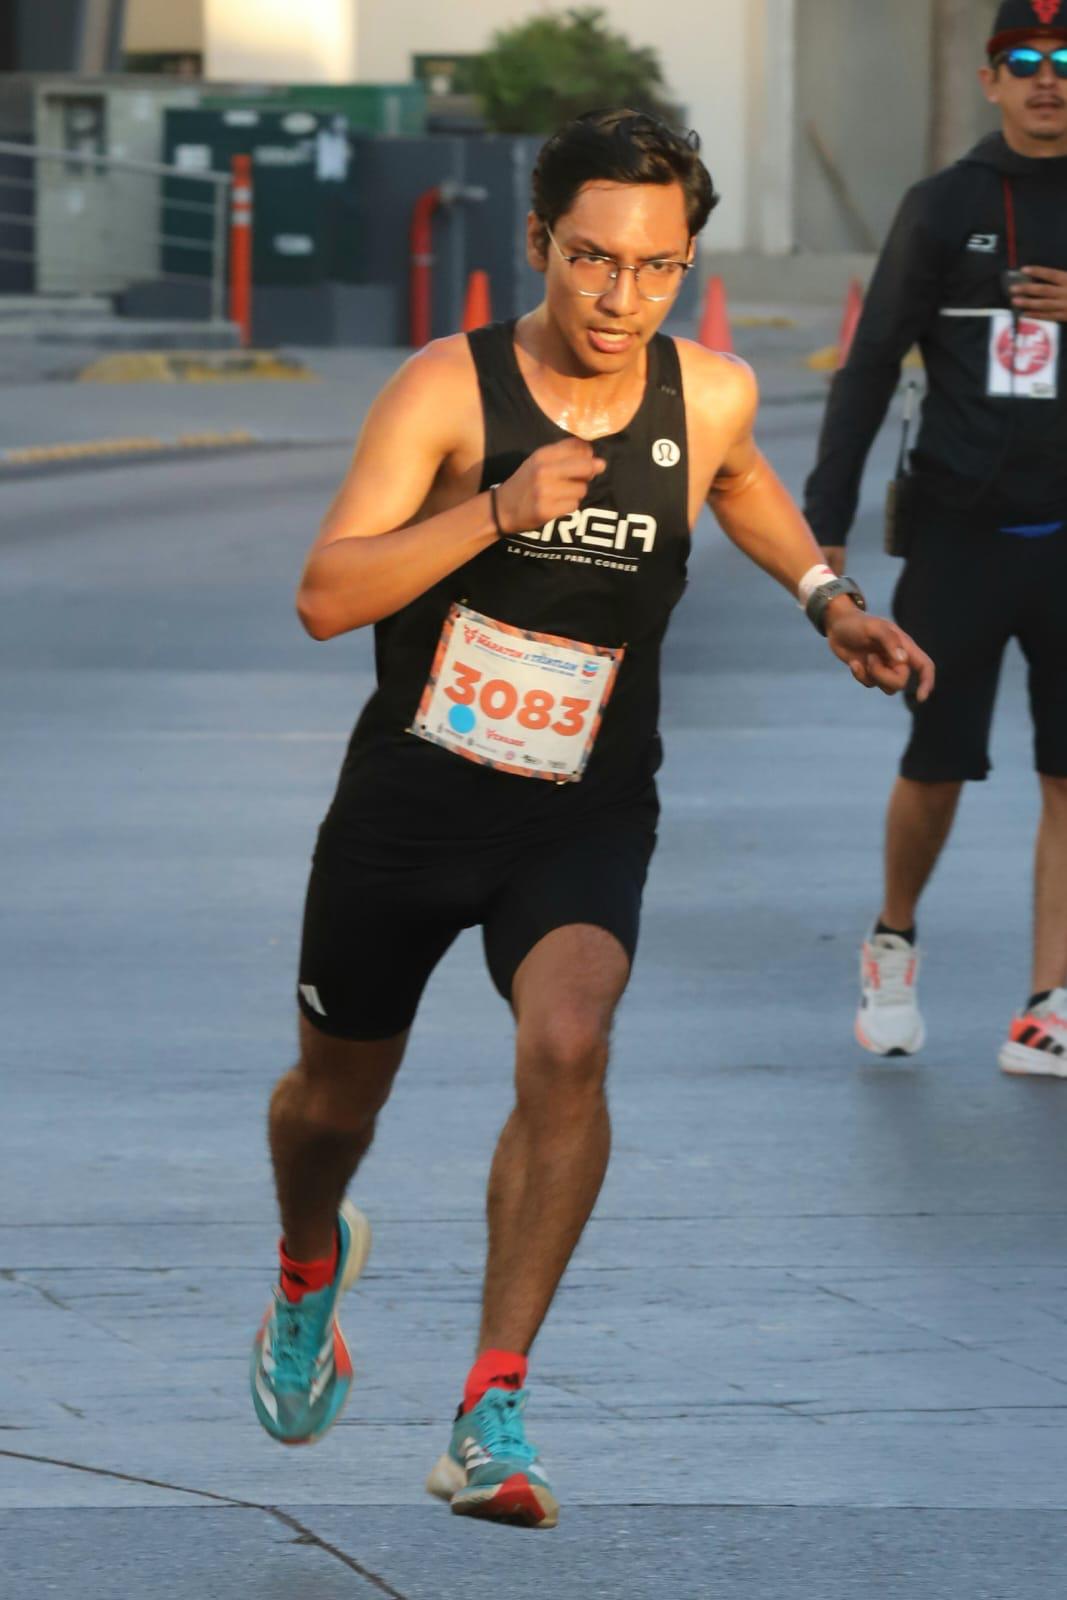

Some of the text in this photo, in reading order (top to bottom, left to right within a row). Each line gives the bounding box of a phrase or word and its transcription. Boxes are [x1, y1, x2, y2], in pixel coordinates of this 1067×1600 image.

[517, 507, 658, 552] REA
[564, 554, 592, 564] PARA
[443, 661, 591, 736] 3083
